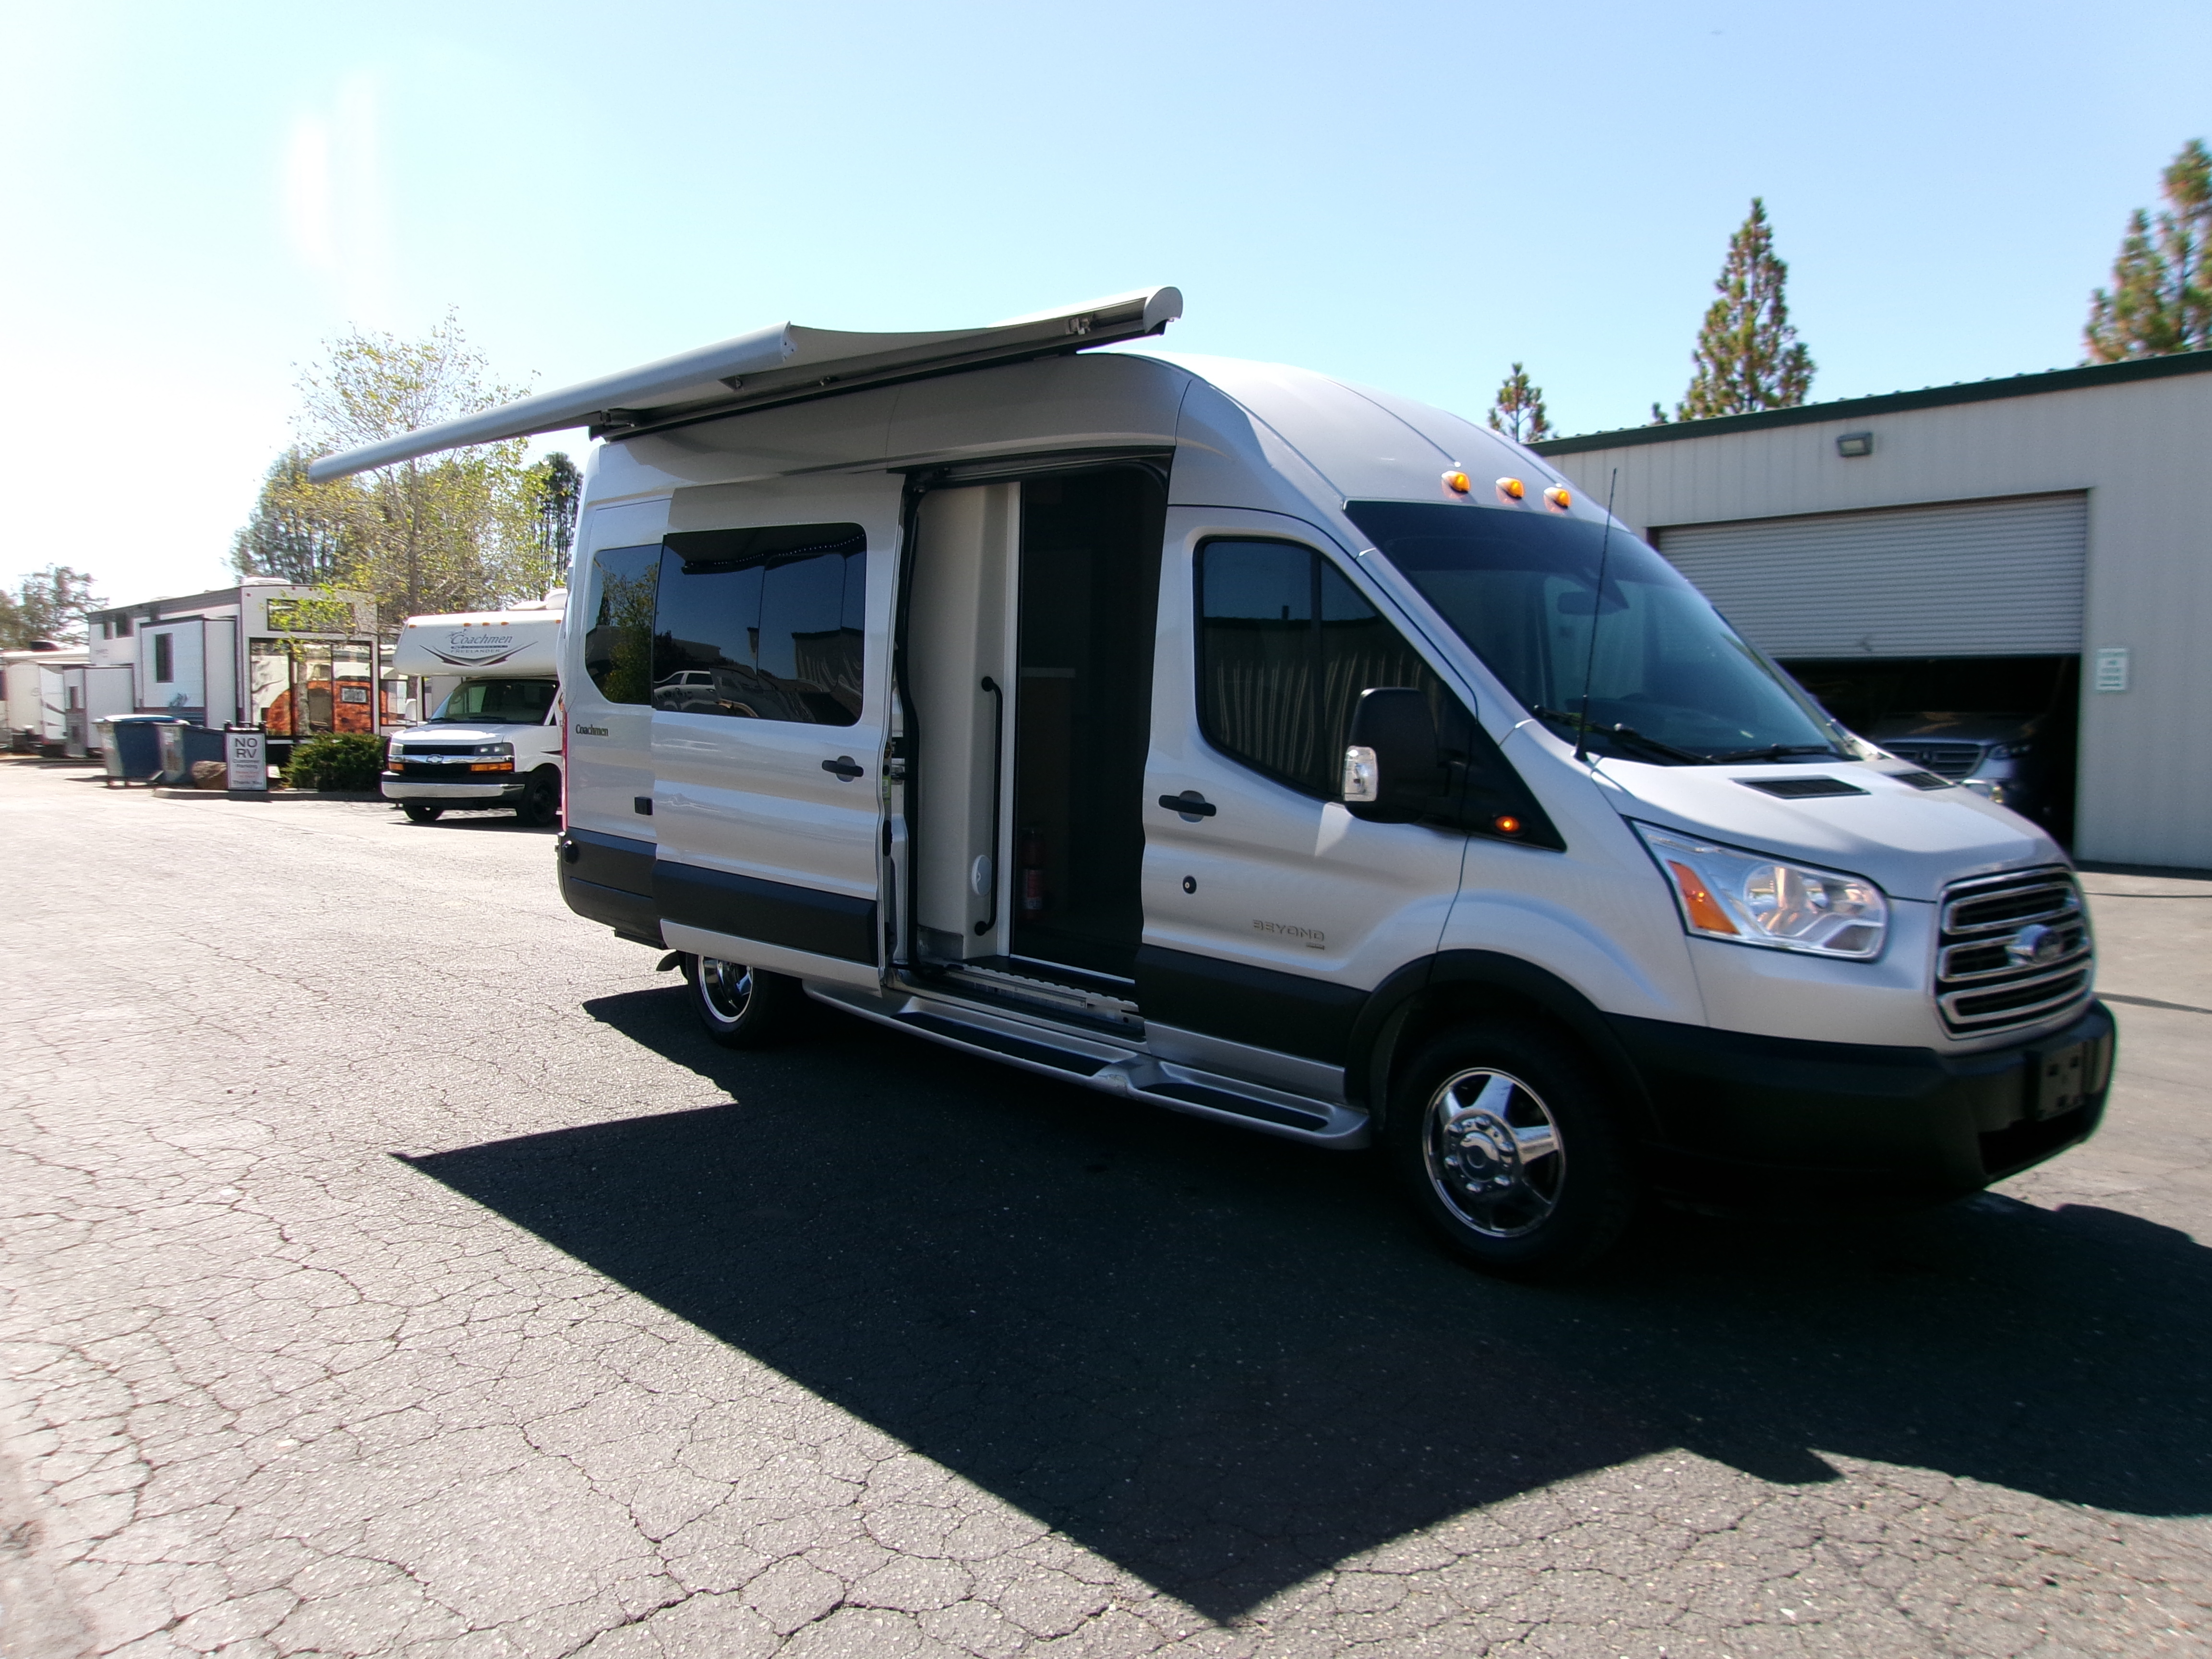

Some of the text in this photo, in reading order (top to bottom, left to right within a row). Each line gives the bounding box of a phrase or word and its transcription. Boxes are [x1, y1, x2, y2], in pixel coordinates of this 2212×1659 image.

[451, 634, 513, 645] Coachmen
[576, 724, 609, 736] Coachmen
[235, 738, 257, 747] NO
[237, 749, 257, 758] RV
[1253, 919, 1324, 941] BEYOND
